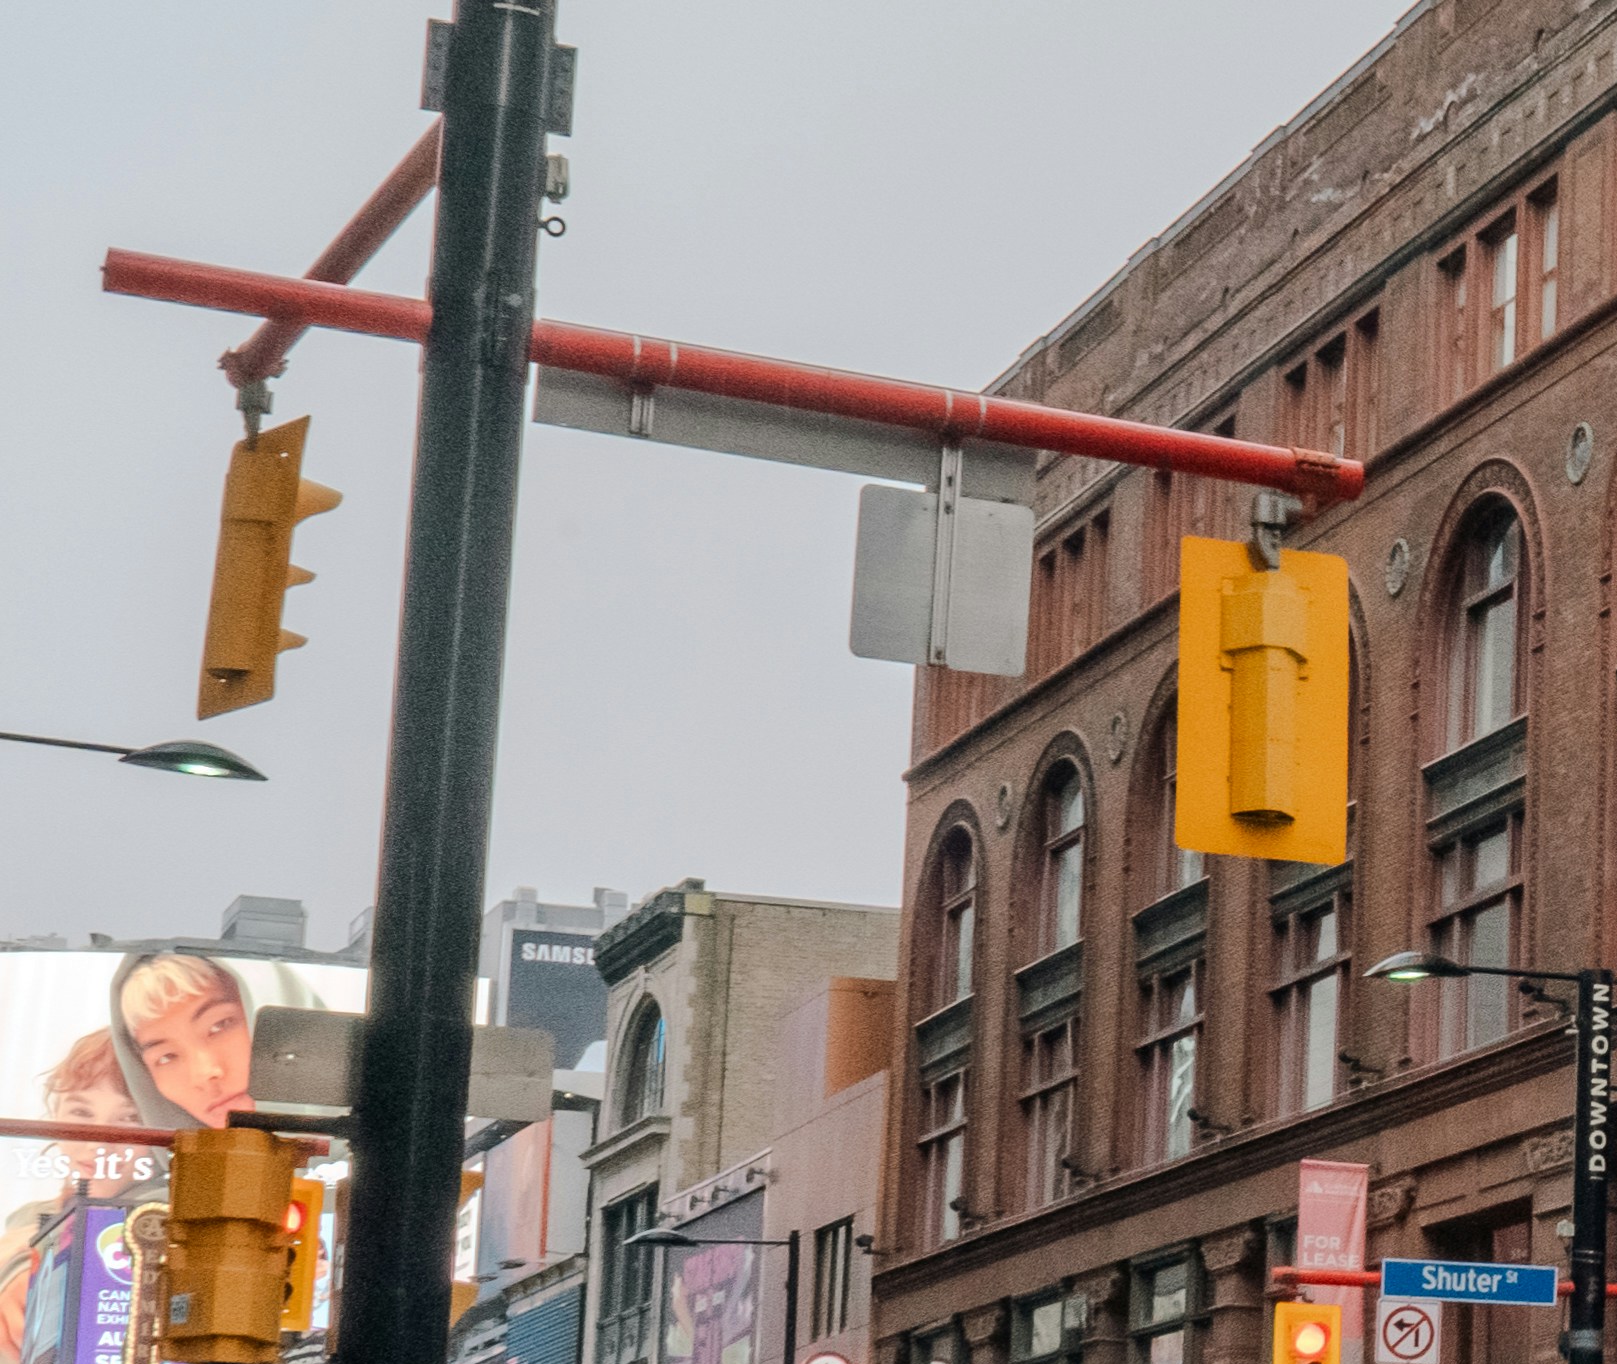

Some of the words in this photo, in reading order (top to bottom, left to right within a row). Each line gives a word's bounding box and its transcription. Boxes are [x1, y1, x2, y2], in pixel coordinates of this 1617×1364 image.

[1589, 982, 1611, 1172] DOWNTOWN
[15, 1149, 82, 1186] Yes,
[93, 1148, 154, 1181] it's
[1303, 1235, 1341, 1251] FOR
[1302, 1251, 1361, 1270] LEASE
[1421, 1266, 1502, 1294] Shuter
[1505, 1270, 1518, 1285] St
